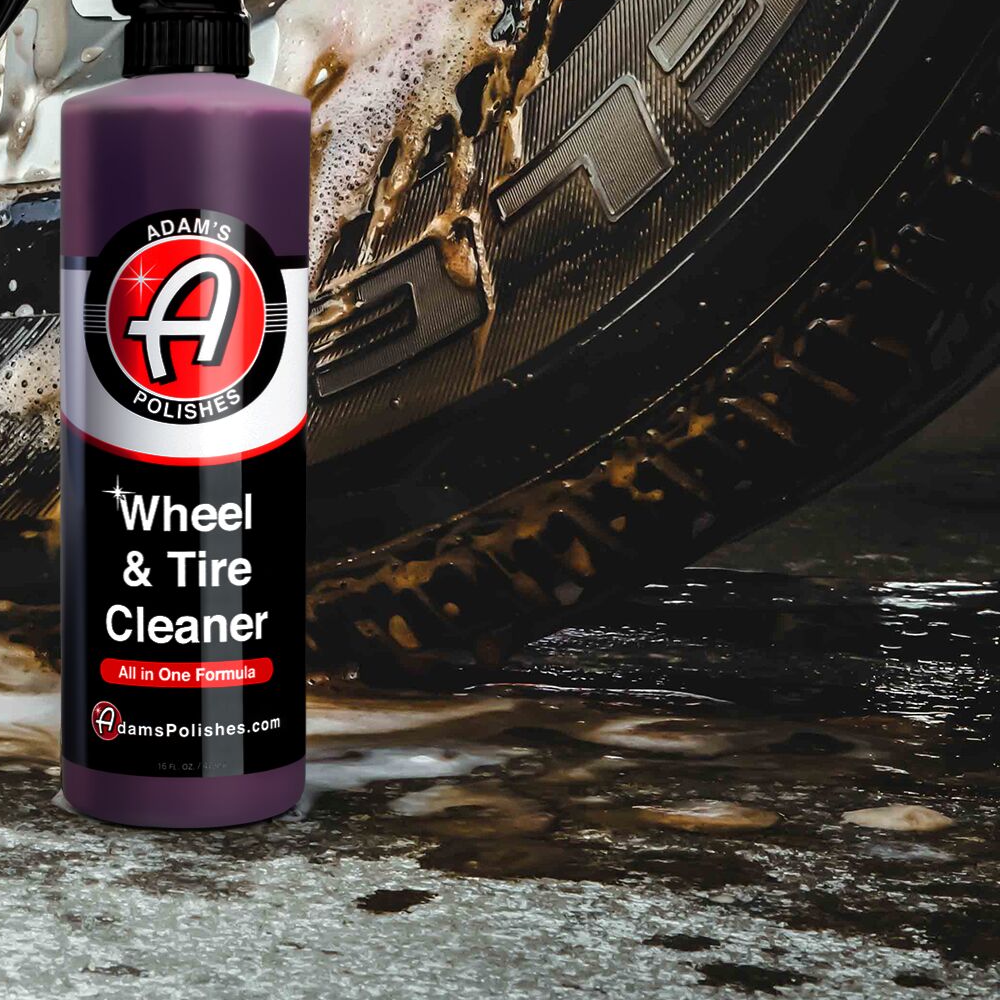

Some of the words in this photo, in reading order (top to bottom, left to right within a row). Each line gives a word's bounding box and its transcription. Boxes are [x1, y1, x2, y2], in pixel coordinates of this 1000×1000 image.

[147, 217, 232, 241] ADAM'S
[133, 388, 241, 419] POLISHES
[120, 493, 252, 532] Wheel
[122, 550, 153, 588] &
[166, 550, 253, 588] Tire
[104, 603, 269, 644] Cleaner
[118, 665, 136, 680] All
[140, 667, 154, 680] in
[158, 667, 191, 682] One
[195, 665, 256, 682] Formula
[95, 706, 281, 738] AdamsPolishes.com
